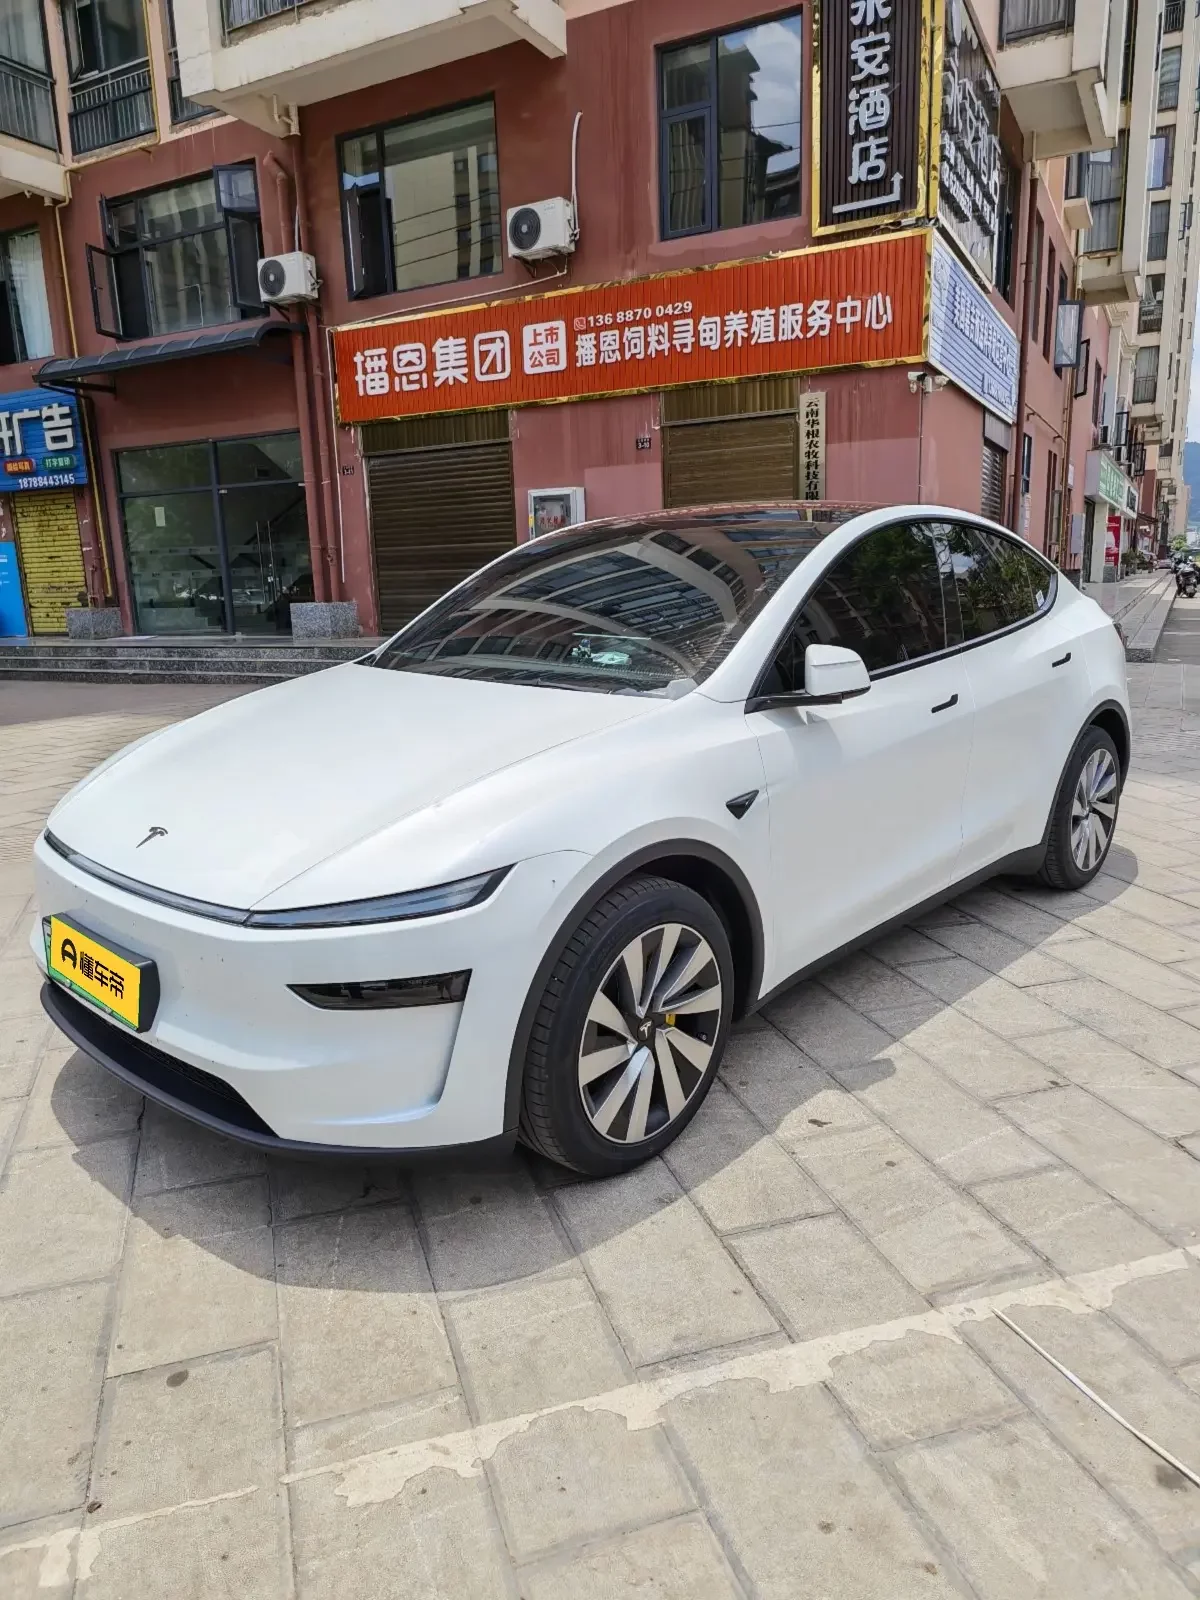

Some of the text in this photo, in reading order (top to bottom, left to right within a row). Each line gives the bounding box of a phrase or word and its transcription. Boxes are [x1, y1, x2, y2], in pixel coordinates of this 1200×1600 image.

[588, 300, 693, 328] 136 8870 0429
[528, 326, 560, 347] 上市
[575, 291, 893, 368] 播恩饲料寻甸养殖服务中心
[353, 329, 511, 396] 播恩集团
[528, 349, 560, 369] 公司
[19, 473, 75, 490] 18788443145
